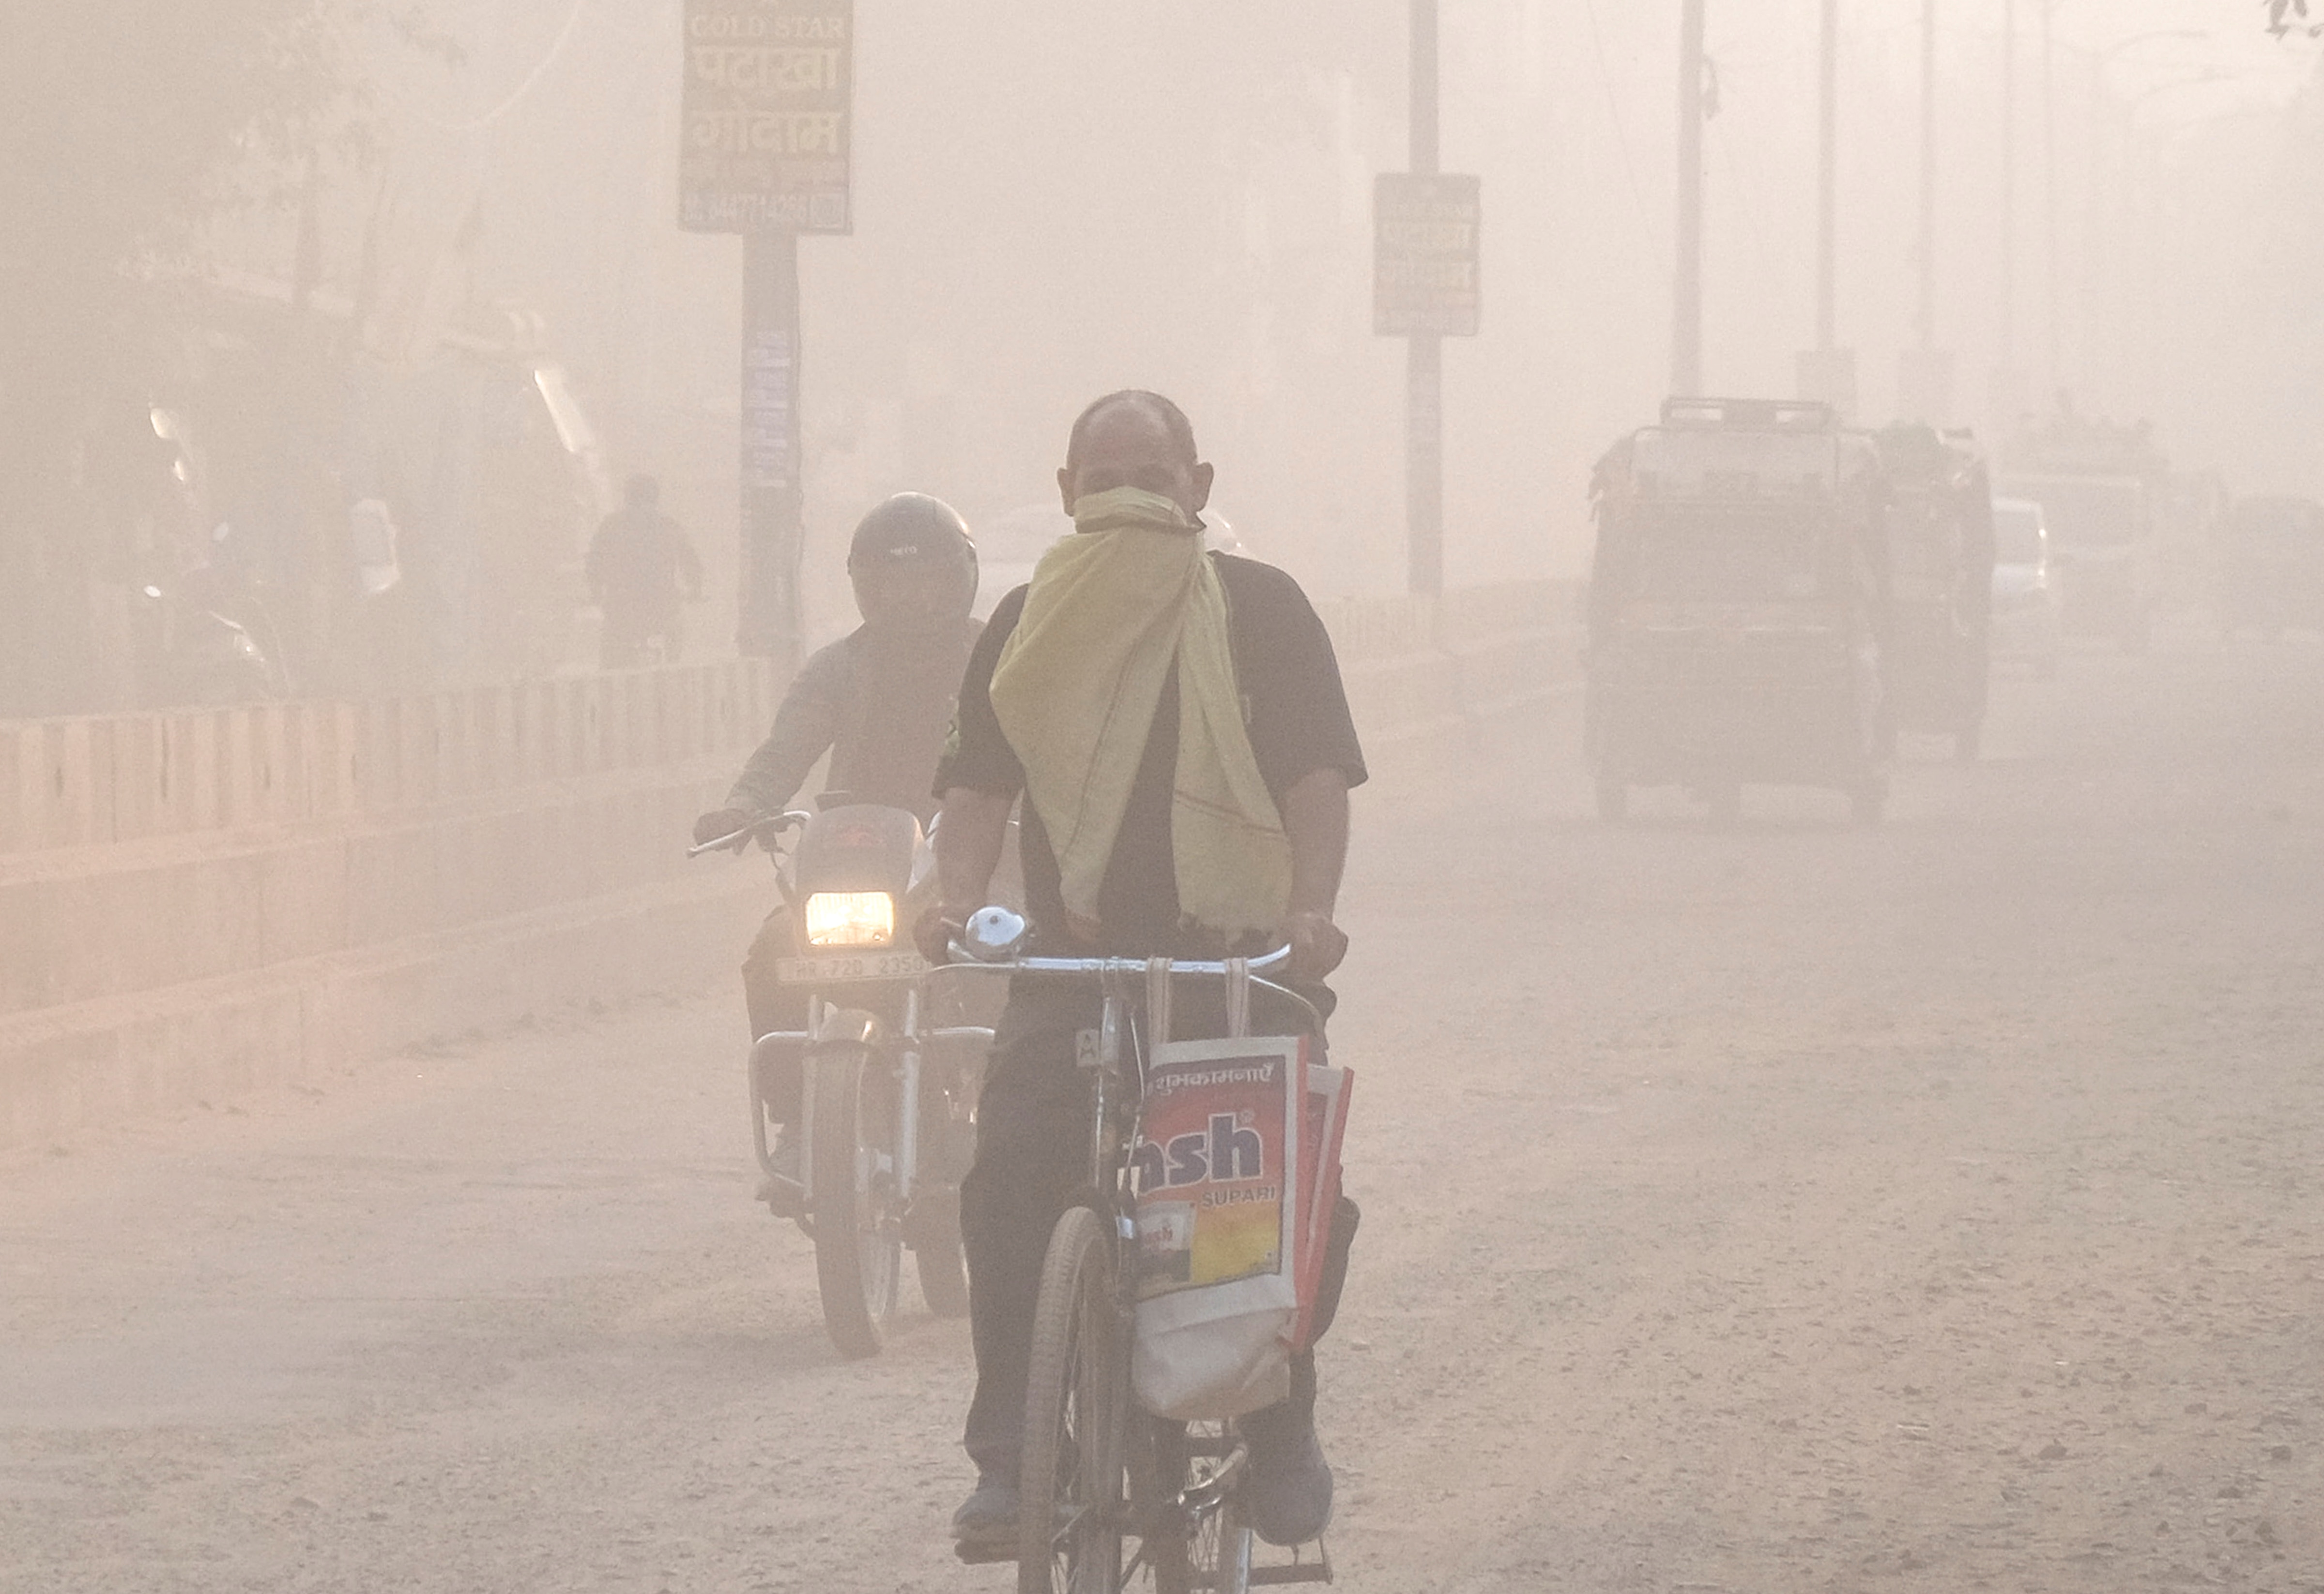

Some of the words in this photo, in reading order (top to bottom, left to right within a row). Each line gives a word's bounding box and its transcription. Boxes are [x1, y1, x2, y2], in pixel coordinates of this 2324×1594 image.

[775, 15, 845, 38] STAR
[691, 46, 841, 90] पटाखा
[690, 93, 842, 154] गोदाम
[1202, 1186, 1276, 1209] SUPARI
